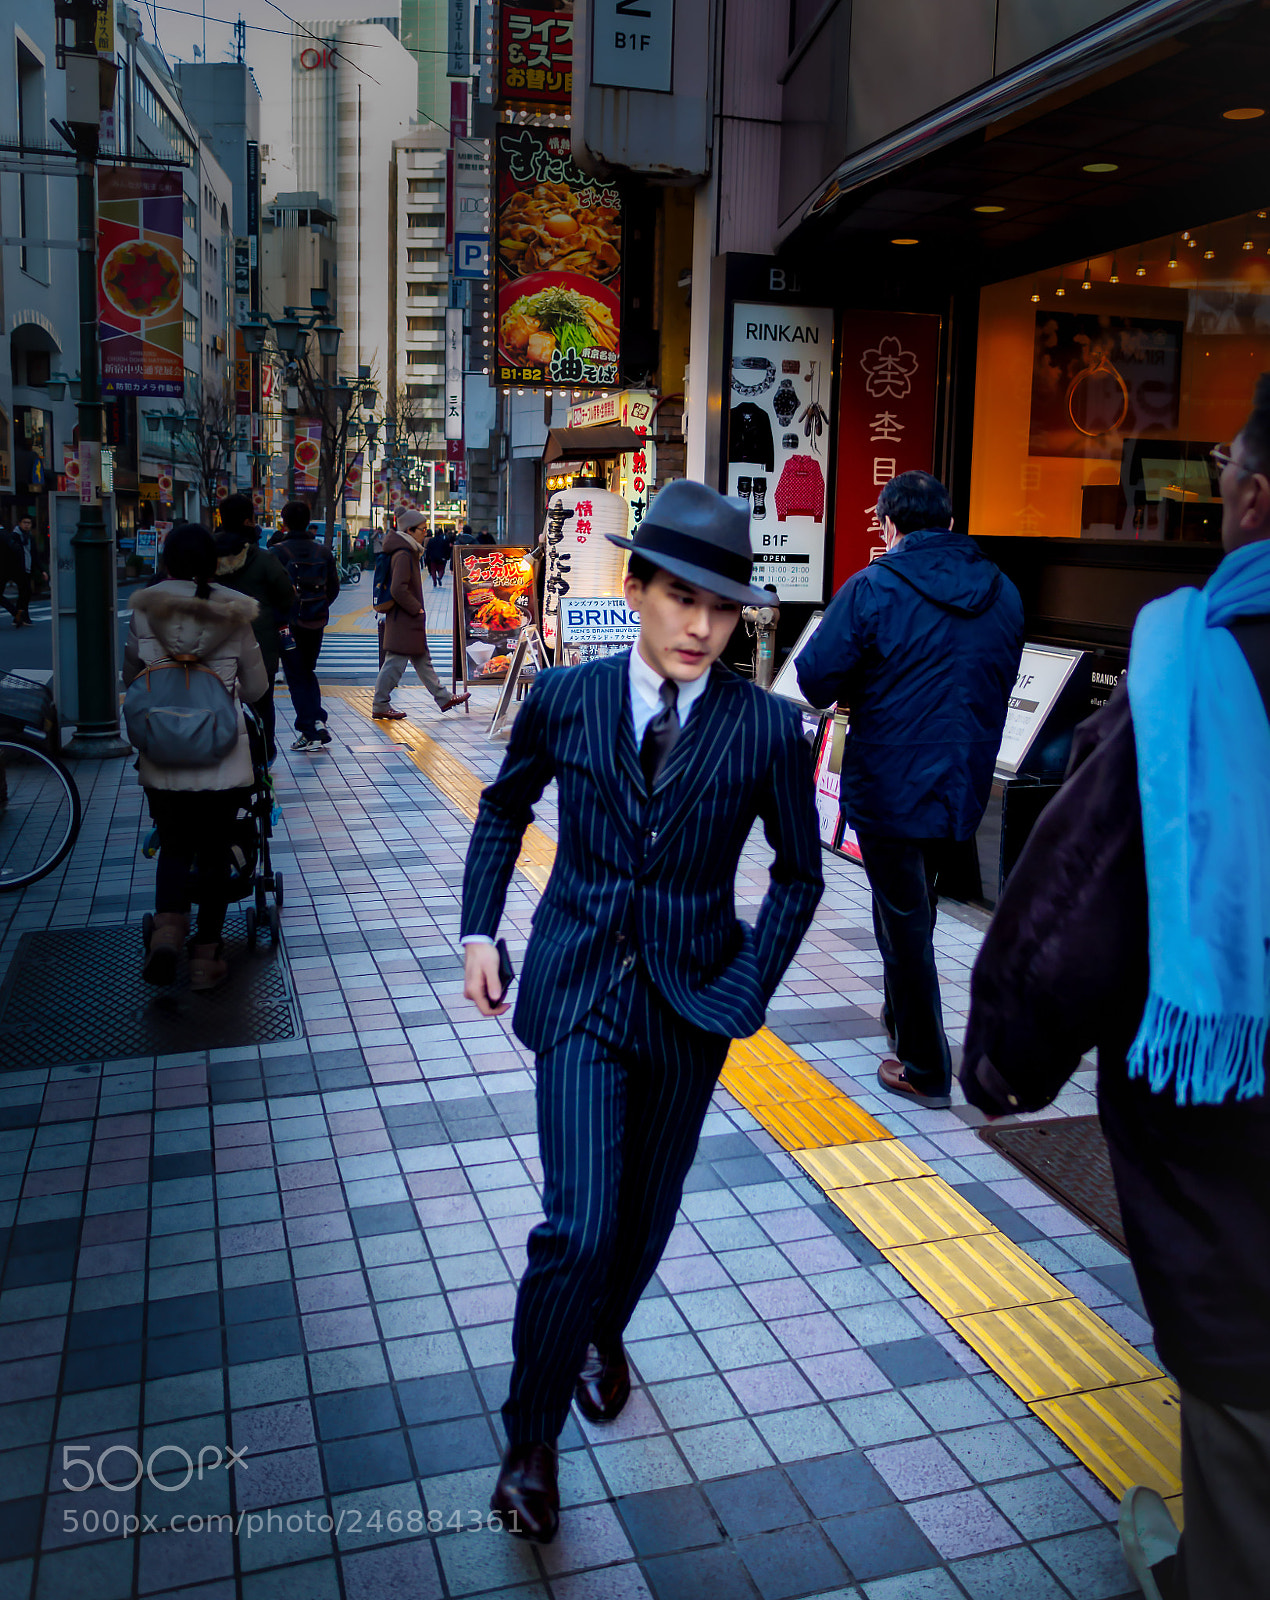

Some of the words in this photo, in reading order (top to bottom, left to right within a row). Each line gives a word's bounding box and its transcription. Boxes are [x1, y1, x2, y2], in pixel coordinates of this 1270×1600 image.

[508, 15, 573, 44] ライス
[615, 32, 651, 51] B1F
[464, 244, 482, 266] P
[746, 322, 819, 344] RINKAN
[550, 347, 618, 384] 油そば
[115, 382, 182, 393] 防犯カメラ作動中
[576, 499, 593, 544] 情熱の
[763, 534, 789, 547] B1F
[463, 552, 505, 571] チーズ
[762, 554, 787, 562] OPEN
[1091, 671, 1119, 687] BRANDS
